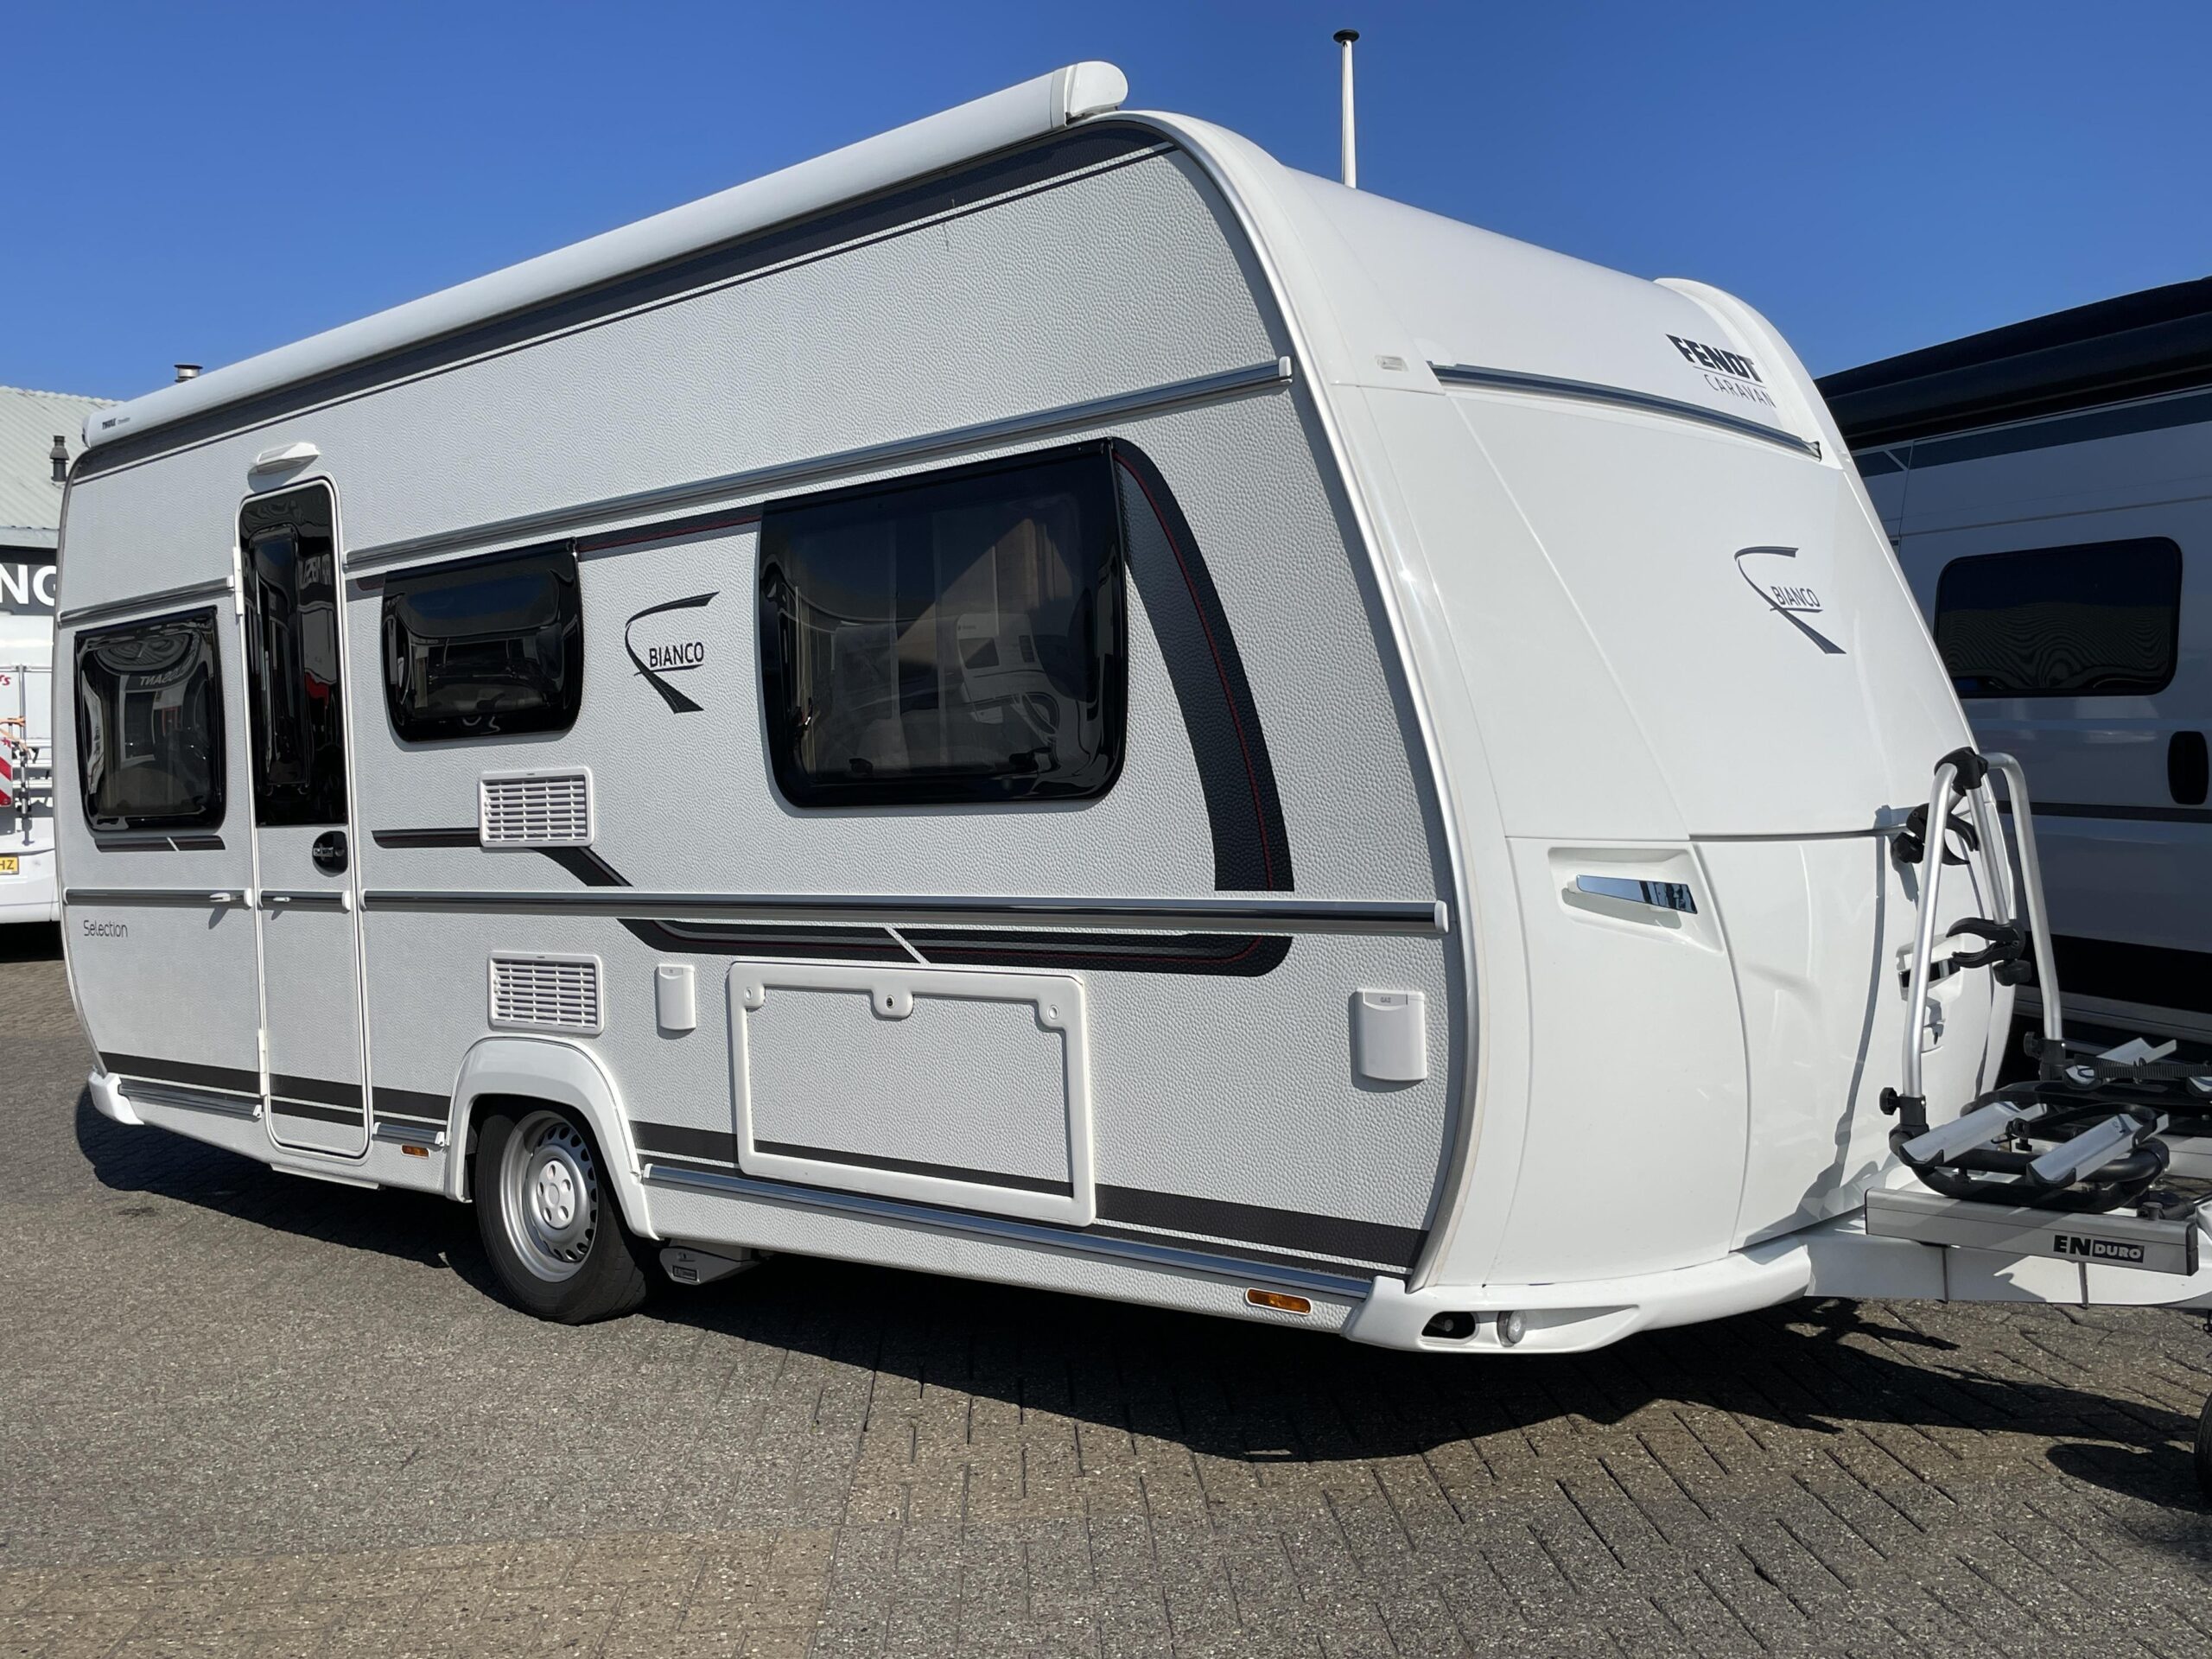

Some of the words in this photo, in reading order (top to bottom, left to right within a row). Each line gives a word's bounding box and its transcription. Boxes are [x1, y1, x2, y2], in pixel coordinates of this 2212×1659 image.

[1664, 334, 1764, 383] FENDT
[1703, 373, 1777, 408] CARAVAN
[1770, 586, 1821, 607] BIANCO
[649, 641, 704, 668] BIANCO
[83, 919, 129, 938] Selection
[2053, 1234, 2143, 1261] ENDURO
